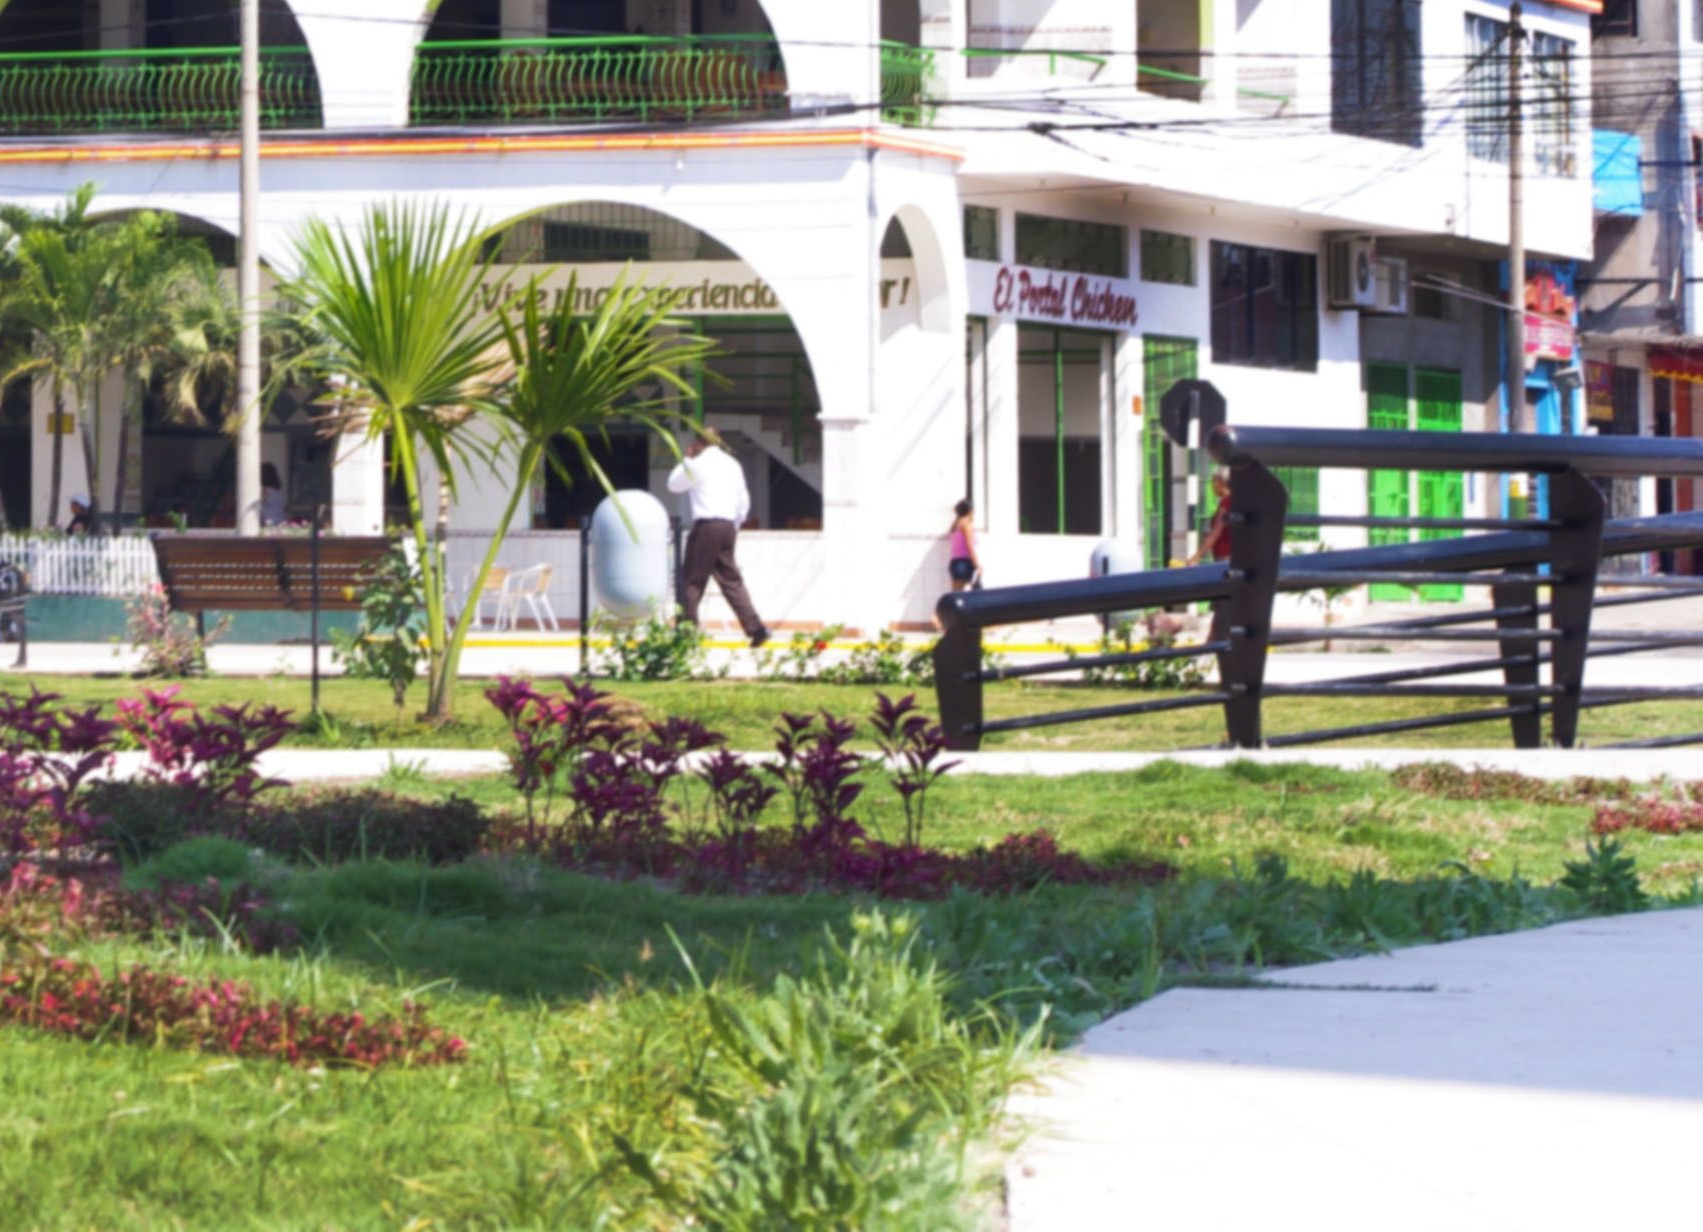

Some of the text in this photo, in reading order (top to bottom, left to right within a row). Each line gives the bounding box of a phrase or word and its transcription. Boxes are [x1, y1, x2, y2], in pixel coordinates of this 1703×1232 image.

[993, 267, 1137, 326] El Portal Chicken
